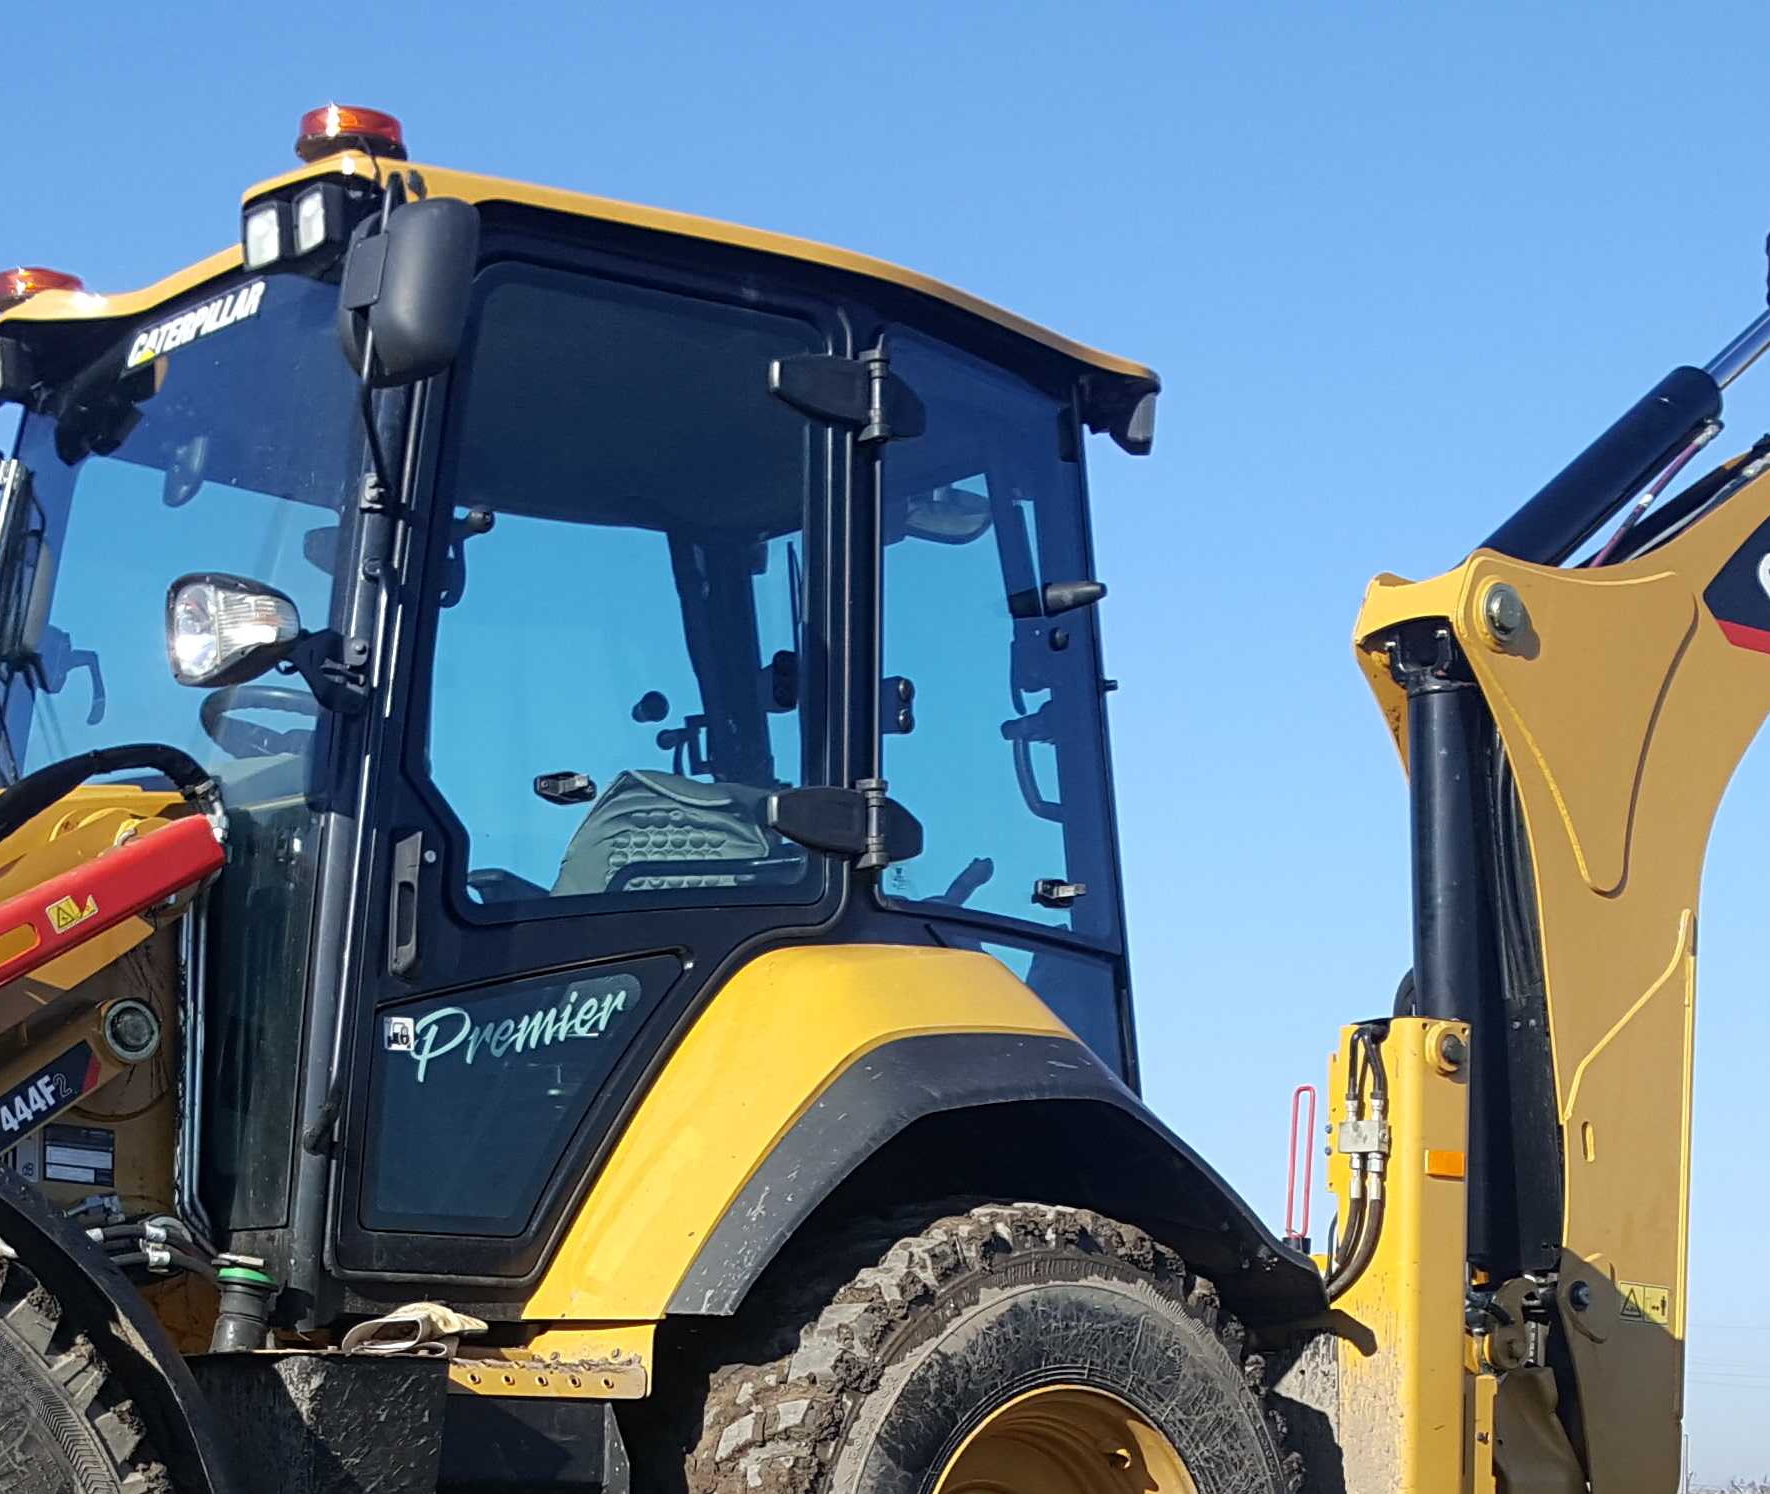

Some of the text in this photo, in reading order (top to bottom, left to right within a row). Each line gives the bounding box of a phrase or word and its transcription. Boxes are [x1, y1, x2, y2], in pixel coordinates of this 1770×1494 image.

[127, 281, 266, 368] CATERPILLAR
[410, 990, 626, 1083] Premier
[0, 1074, 72, 1132] 444F2
